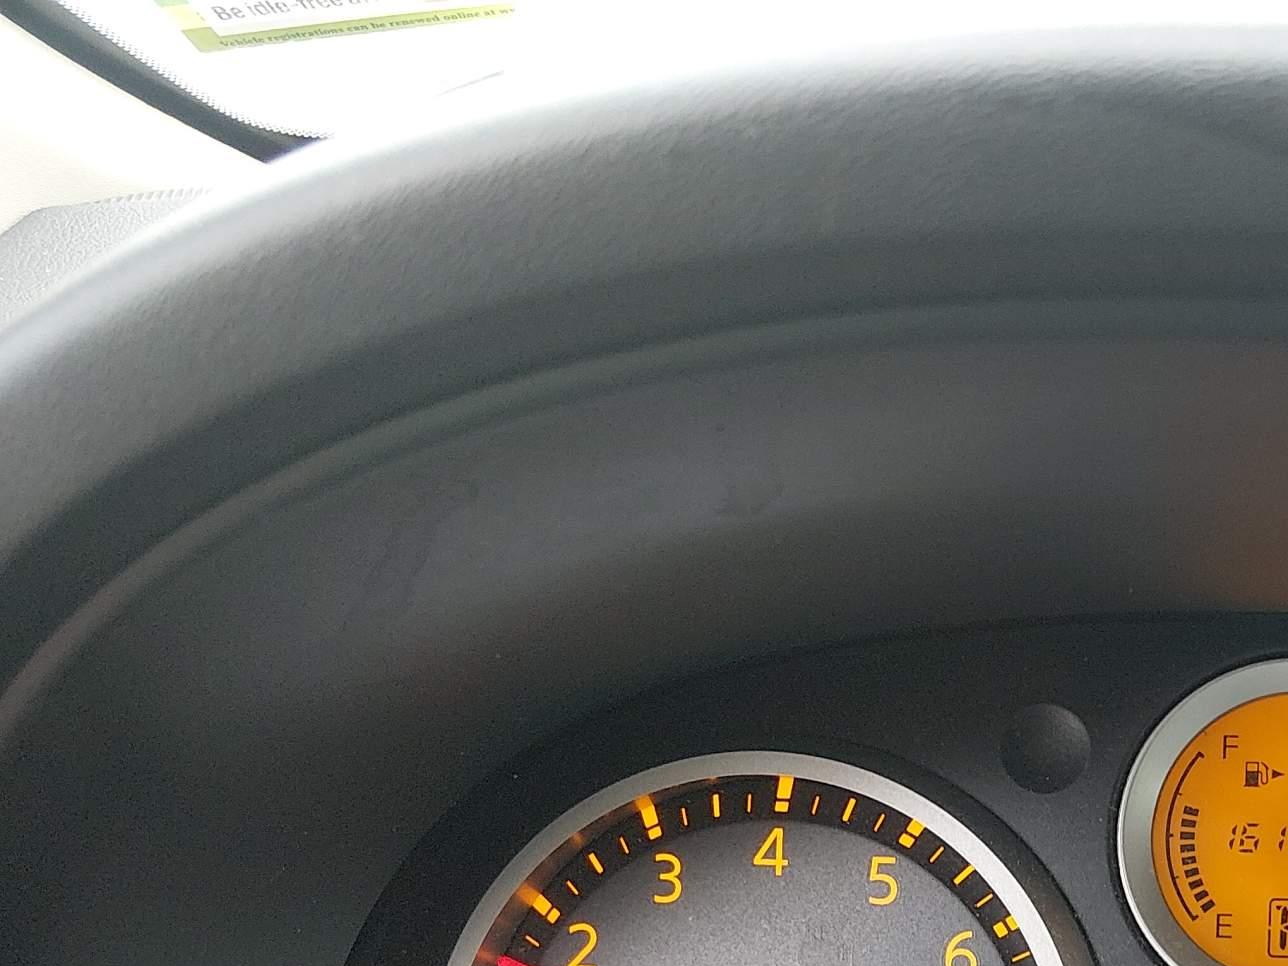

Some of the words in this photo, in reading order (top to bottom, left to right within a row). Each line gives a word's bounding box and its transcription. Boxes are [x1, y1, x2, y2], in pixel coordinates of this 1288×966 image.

[211, 6, 246, 20] Be
[220, 37, 265, 47] Vehicle
[267, 26, 344, 43] registrations
[346, 23, 369, 31] can
[389, 15, 440, 27] renewed
[443, 11, 481, 21] online
[1222, 735, 1239, 759] F
[752, 827, 789, 877] 4
[652, 852, 683, 905] 3
[868, 854, 900, 906] 5
[1216, 914, 1232, 938] E
